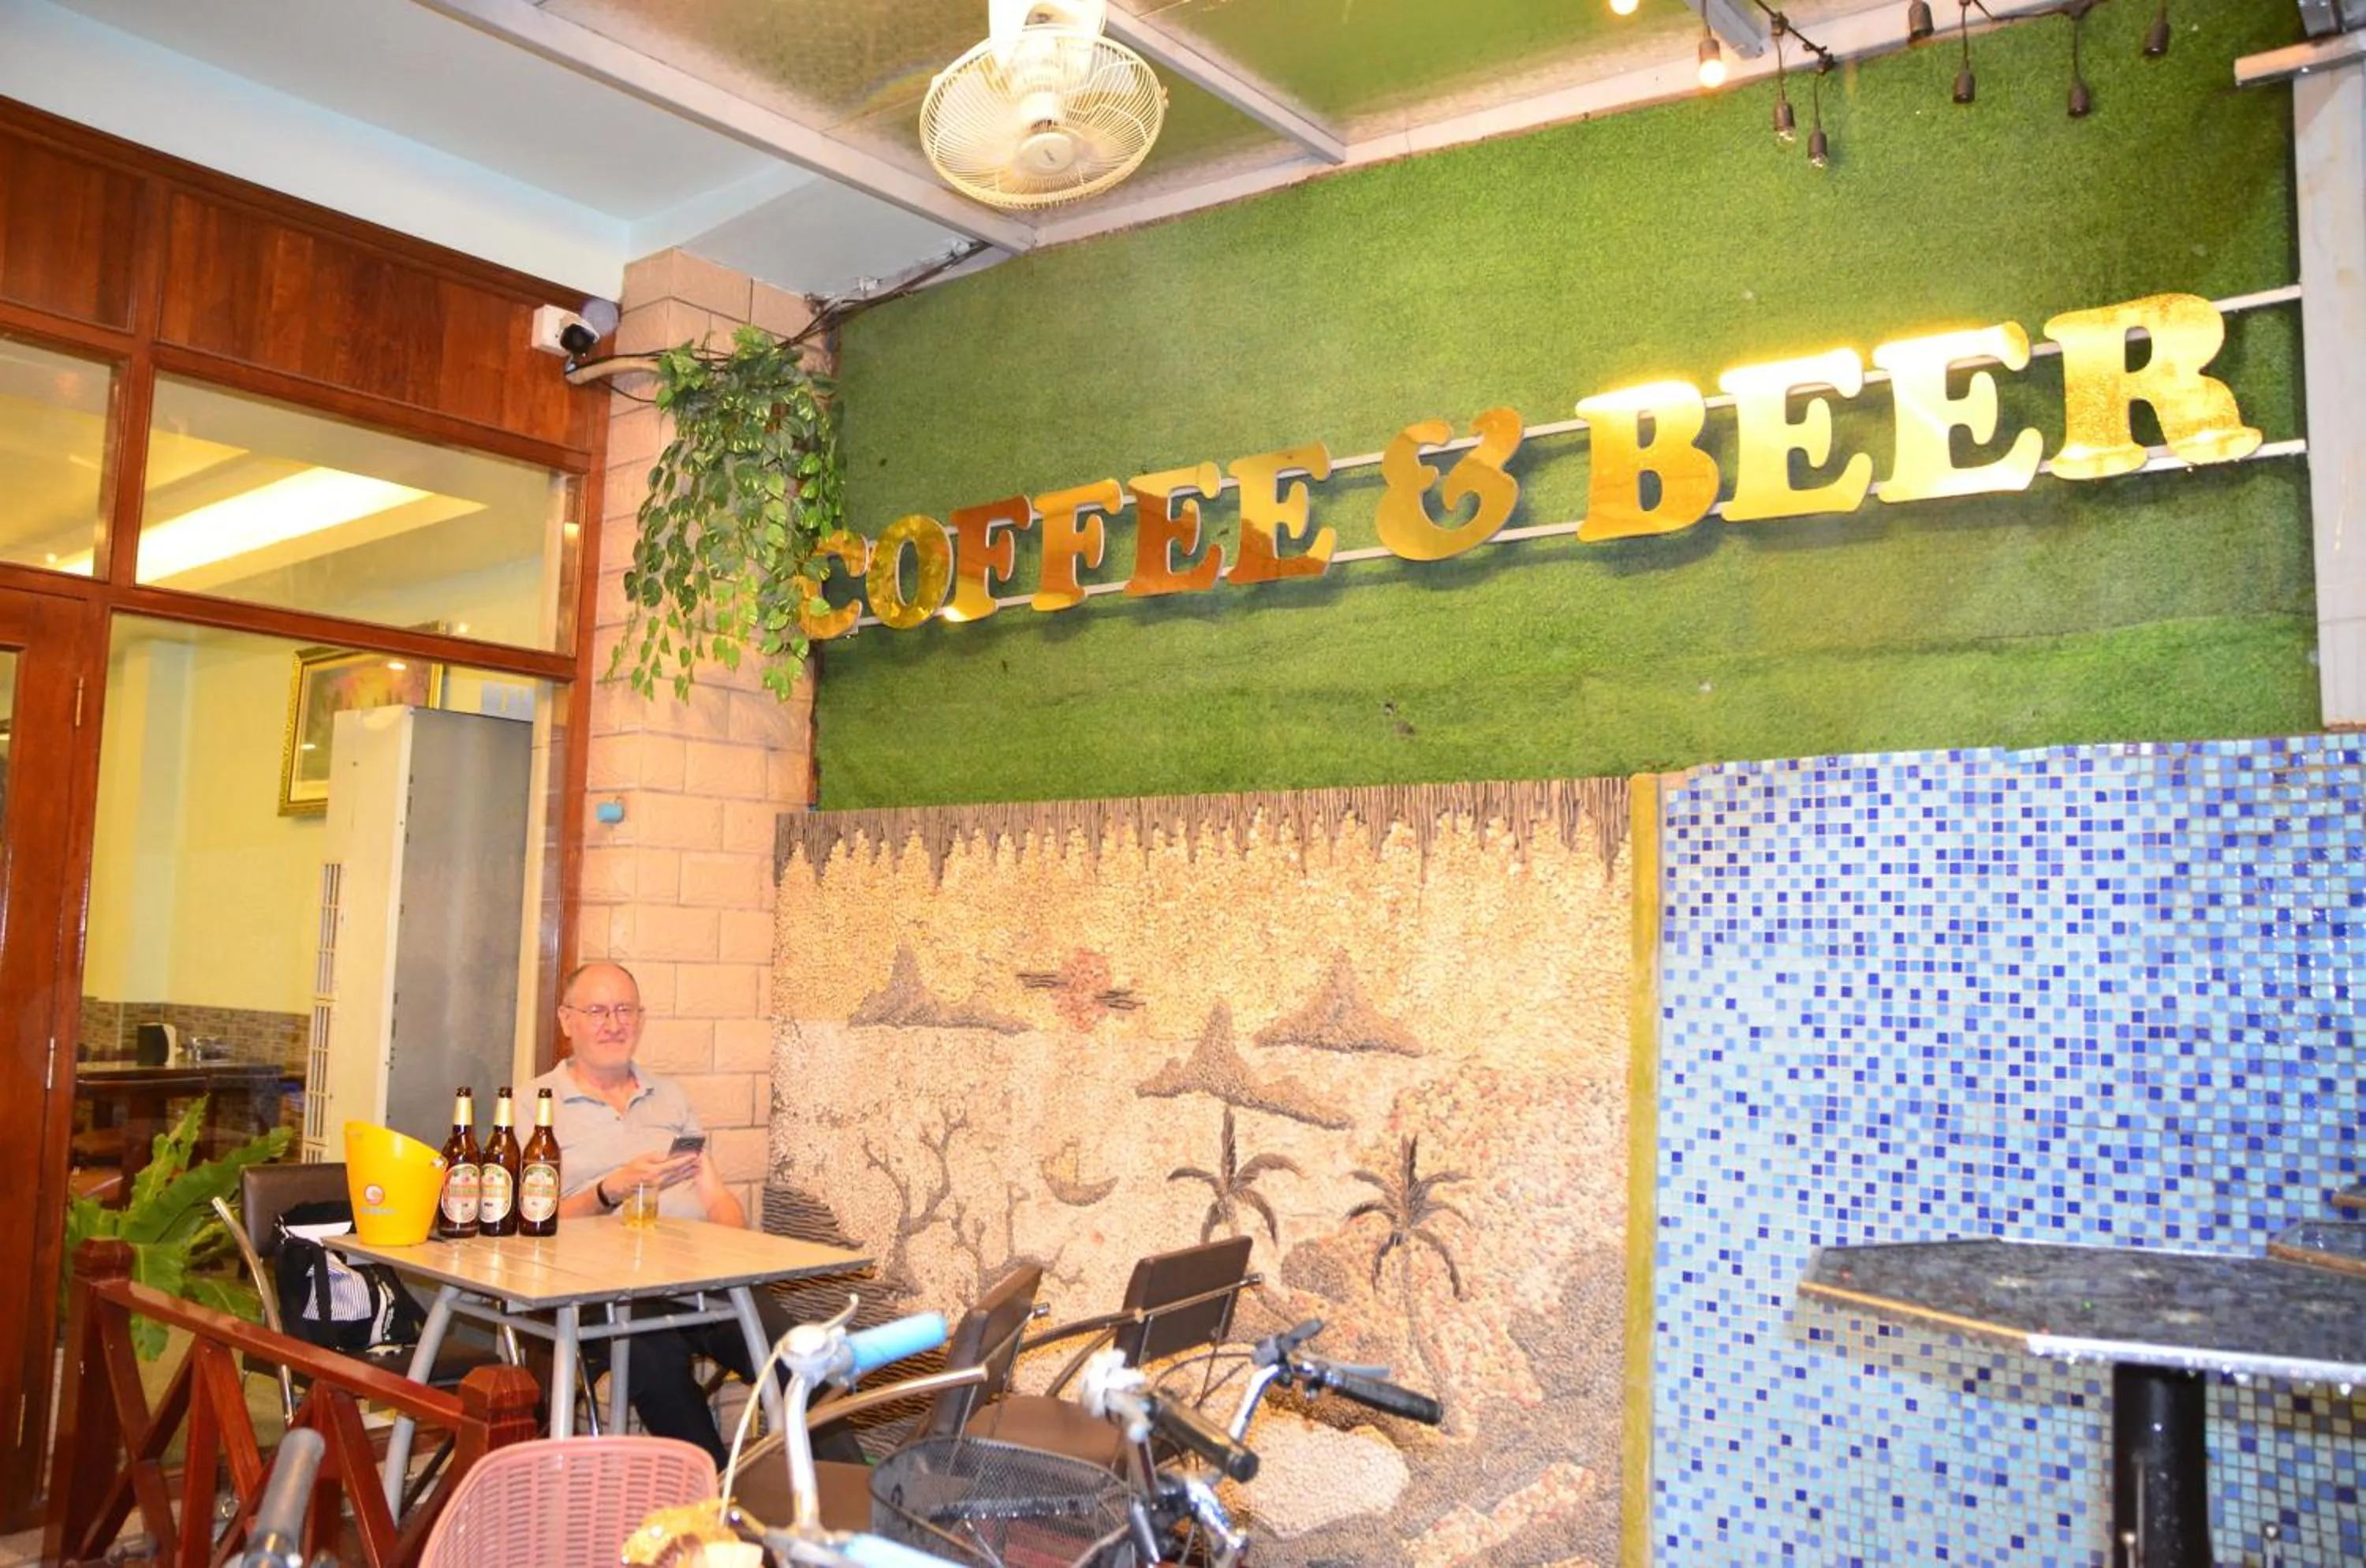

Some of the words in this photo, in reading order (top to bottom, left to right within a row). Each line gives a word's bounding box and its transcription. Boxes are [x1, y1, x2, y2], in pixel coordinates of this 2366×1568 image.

[792, 440, 1337, 640] COFFEE
[1375, 406, 1524, 562] &
[1574, 292, 2263, 543] BEER
